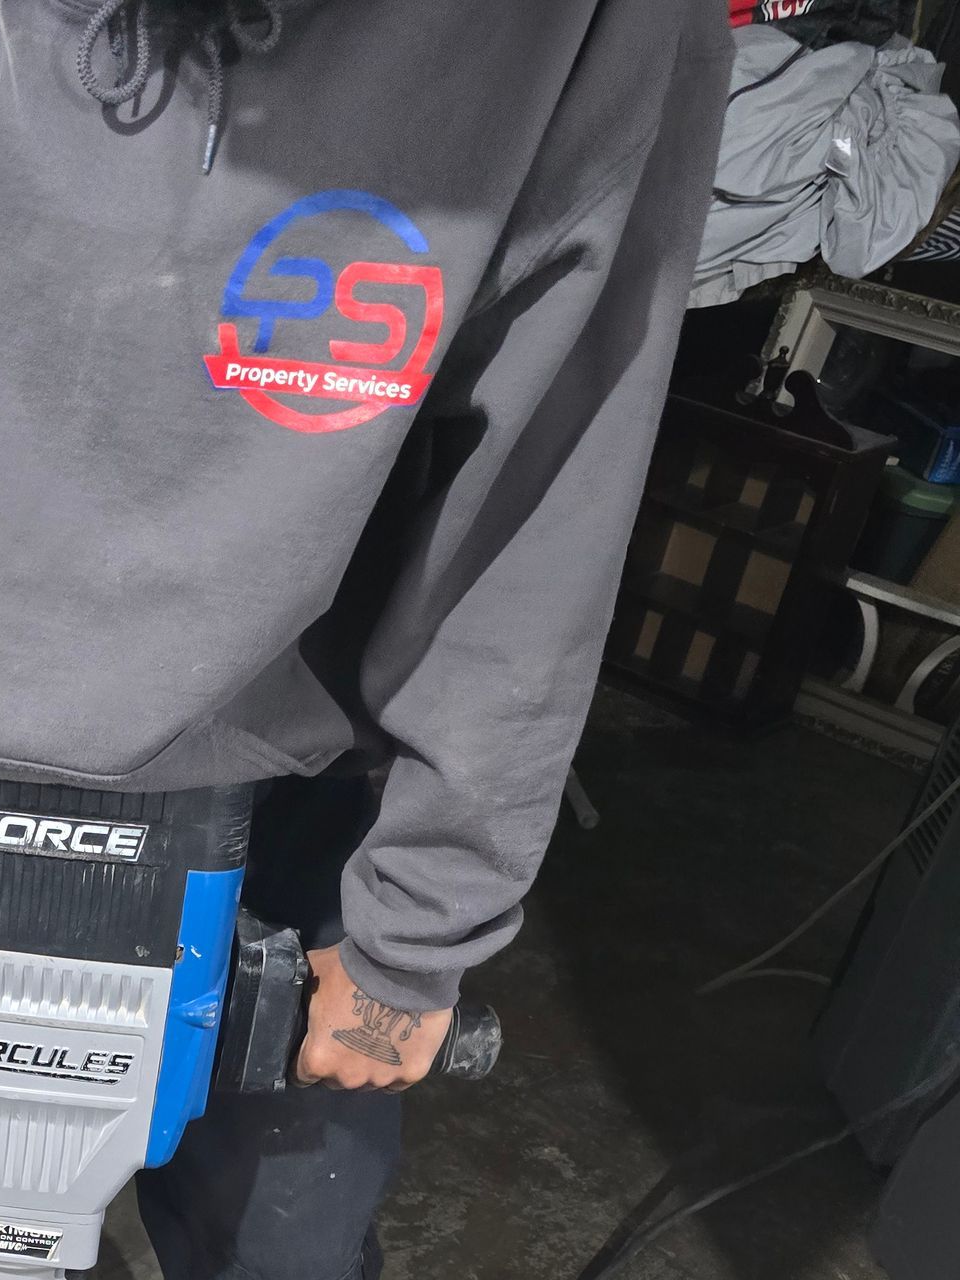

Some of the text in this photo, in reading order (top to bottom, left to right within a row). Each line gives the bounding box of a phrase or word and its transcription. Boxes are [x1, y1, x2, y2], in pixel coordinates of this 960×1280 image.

[225, 363, 412, 399] Property Services
[15, 1236, 56, 1246] CONTROL
